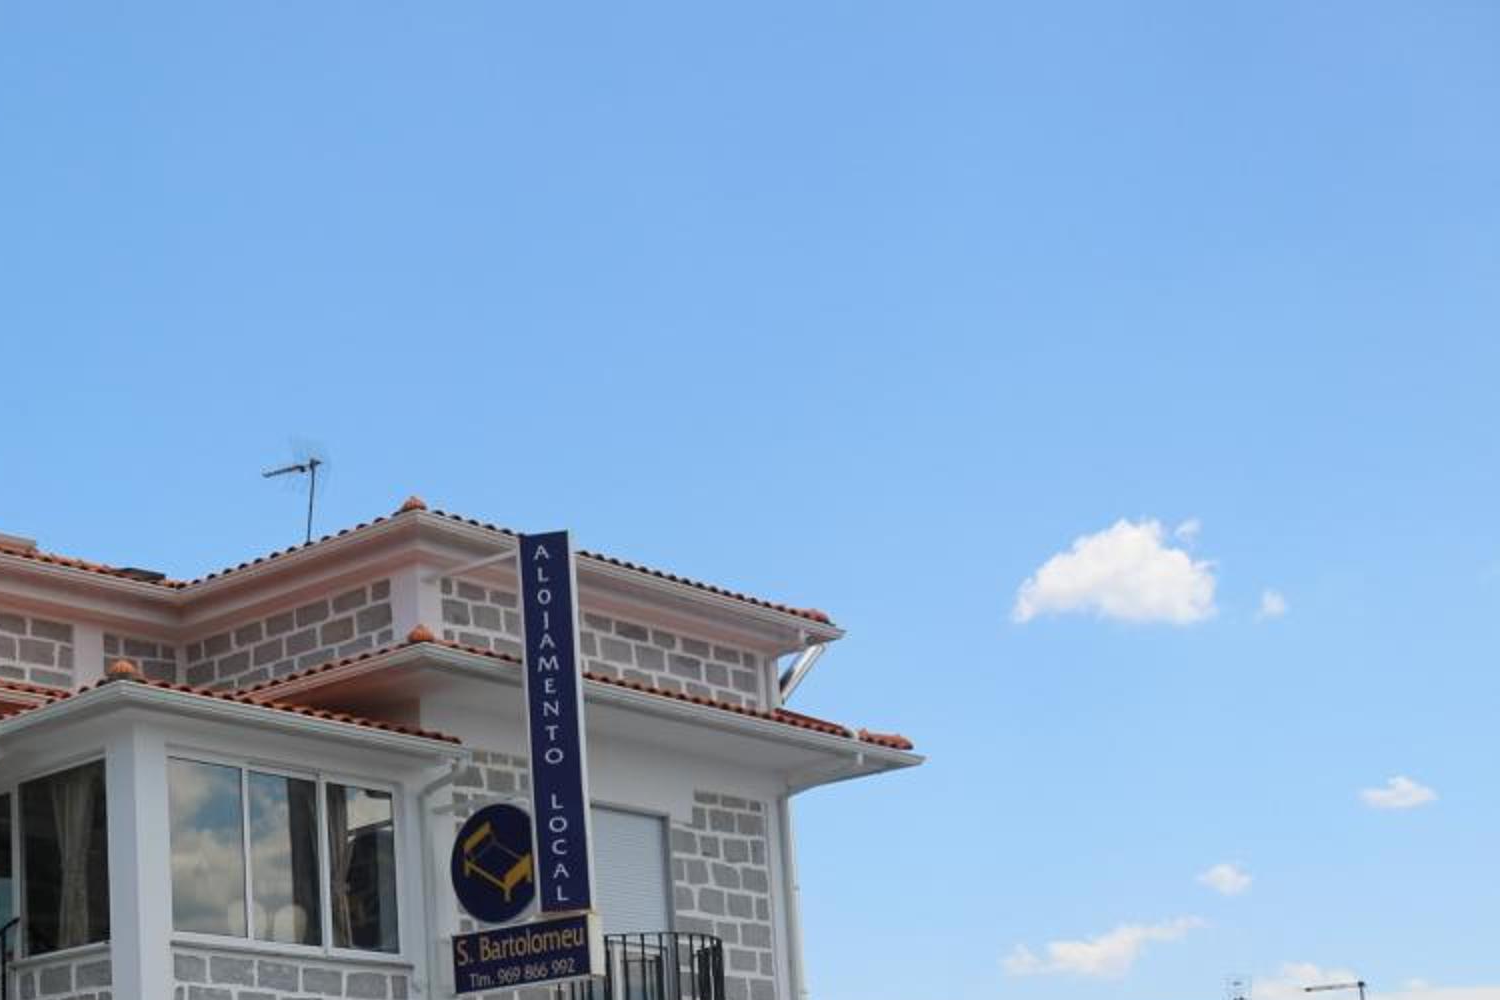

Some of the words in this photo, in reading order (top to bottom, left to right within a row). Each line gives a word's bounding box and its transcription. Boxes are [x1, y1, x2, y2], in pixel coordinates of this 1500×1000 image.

[549, 793, 570, 901] LOCAL
[456, 939, 474, 967] S.
[480, 927, 585, 961] Bartolomeu
[497, 966, 521, 984] 969
[550, 957, 576, 975] 992
